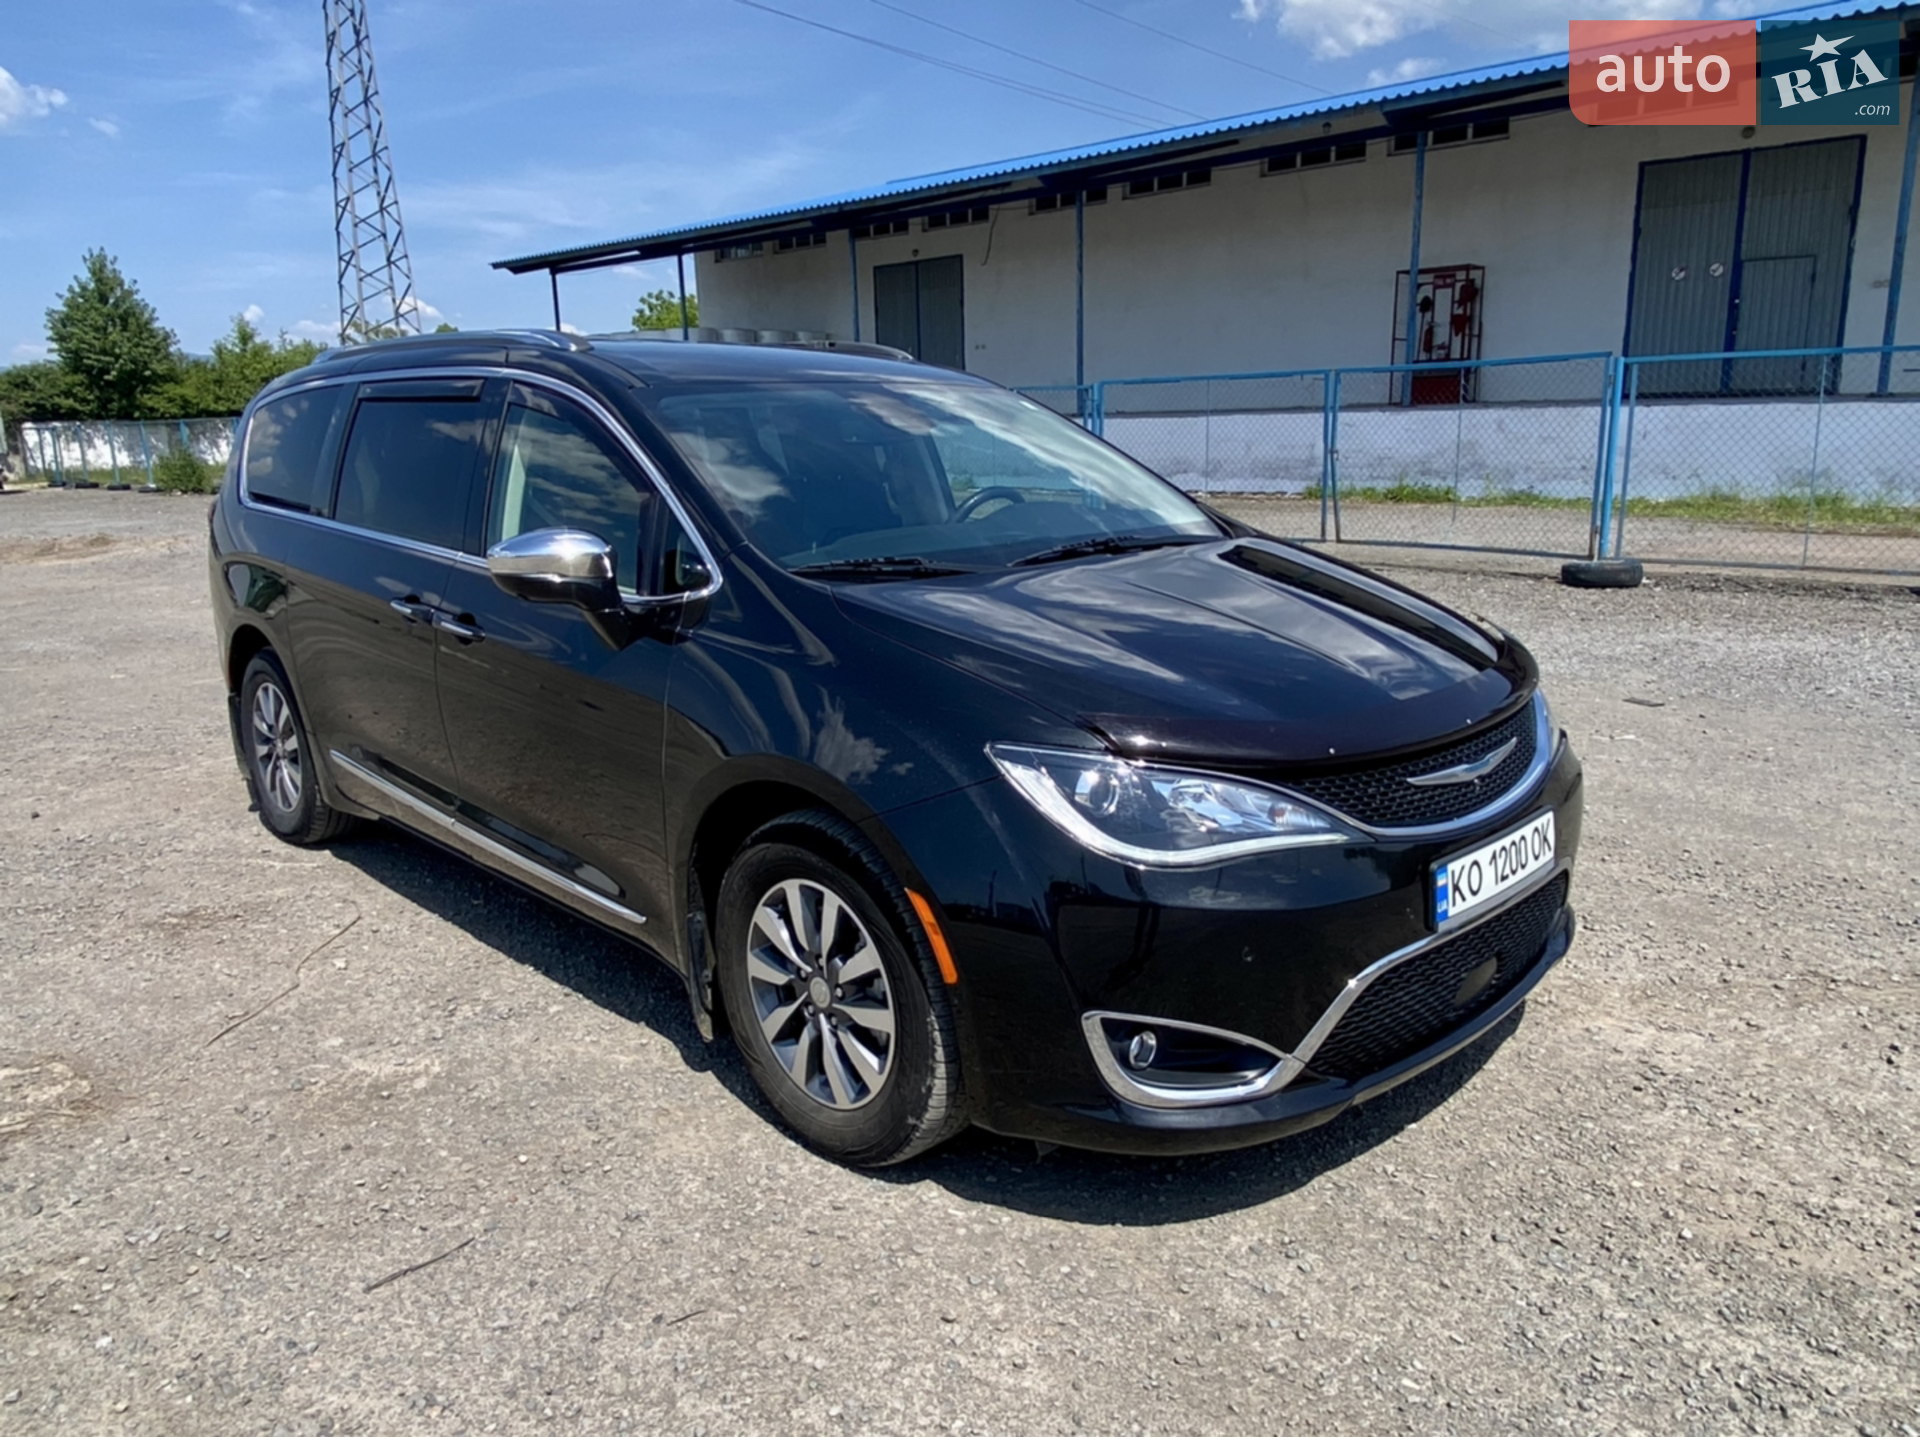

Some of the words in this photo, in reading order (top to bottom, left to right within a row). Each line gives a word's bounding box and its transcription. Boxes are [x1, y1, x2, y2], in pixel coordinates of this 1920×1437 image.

[1451, 859, 1483, 907] KO
[1489, 835, 1529, 885] 1200
[1531, 818, 1552, 861] OK
